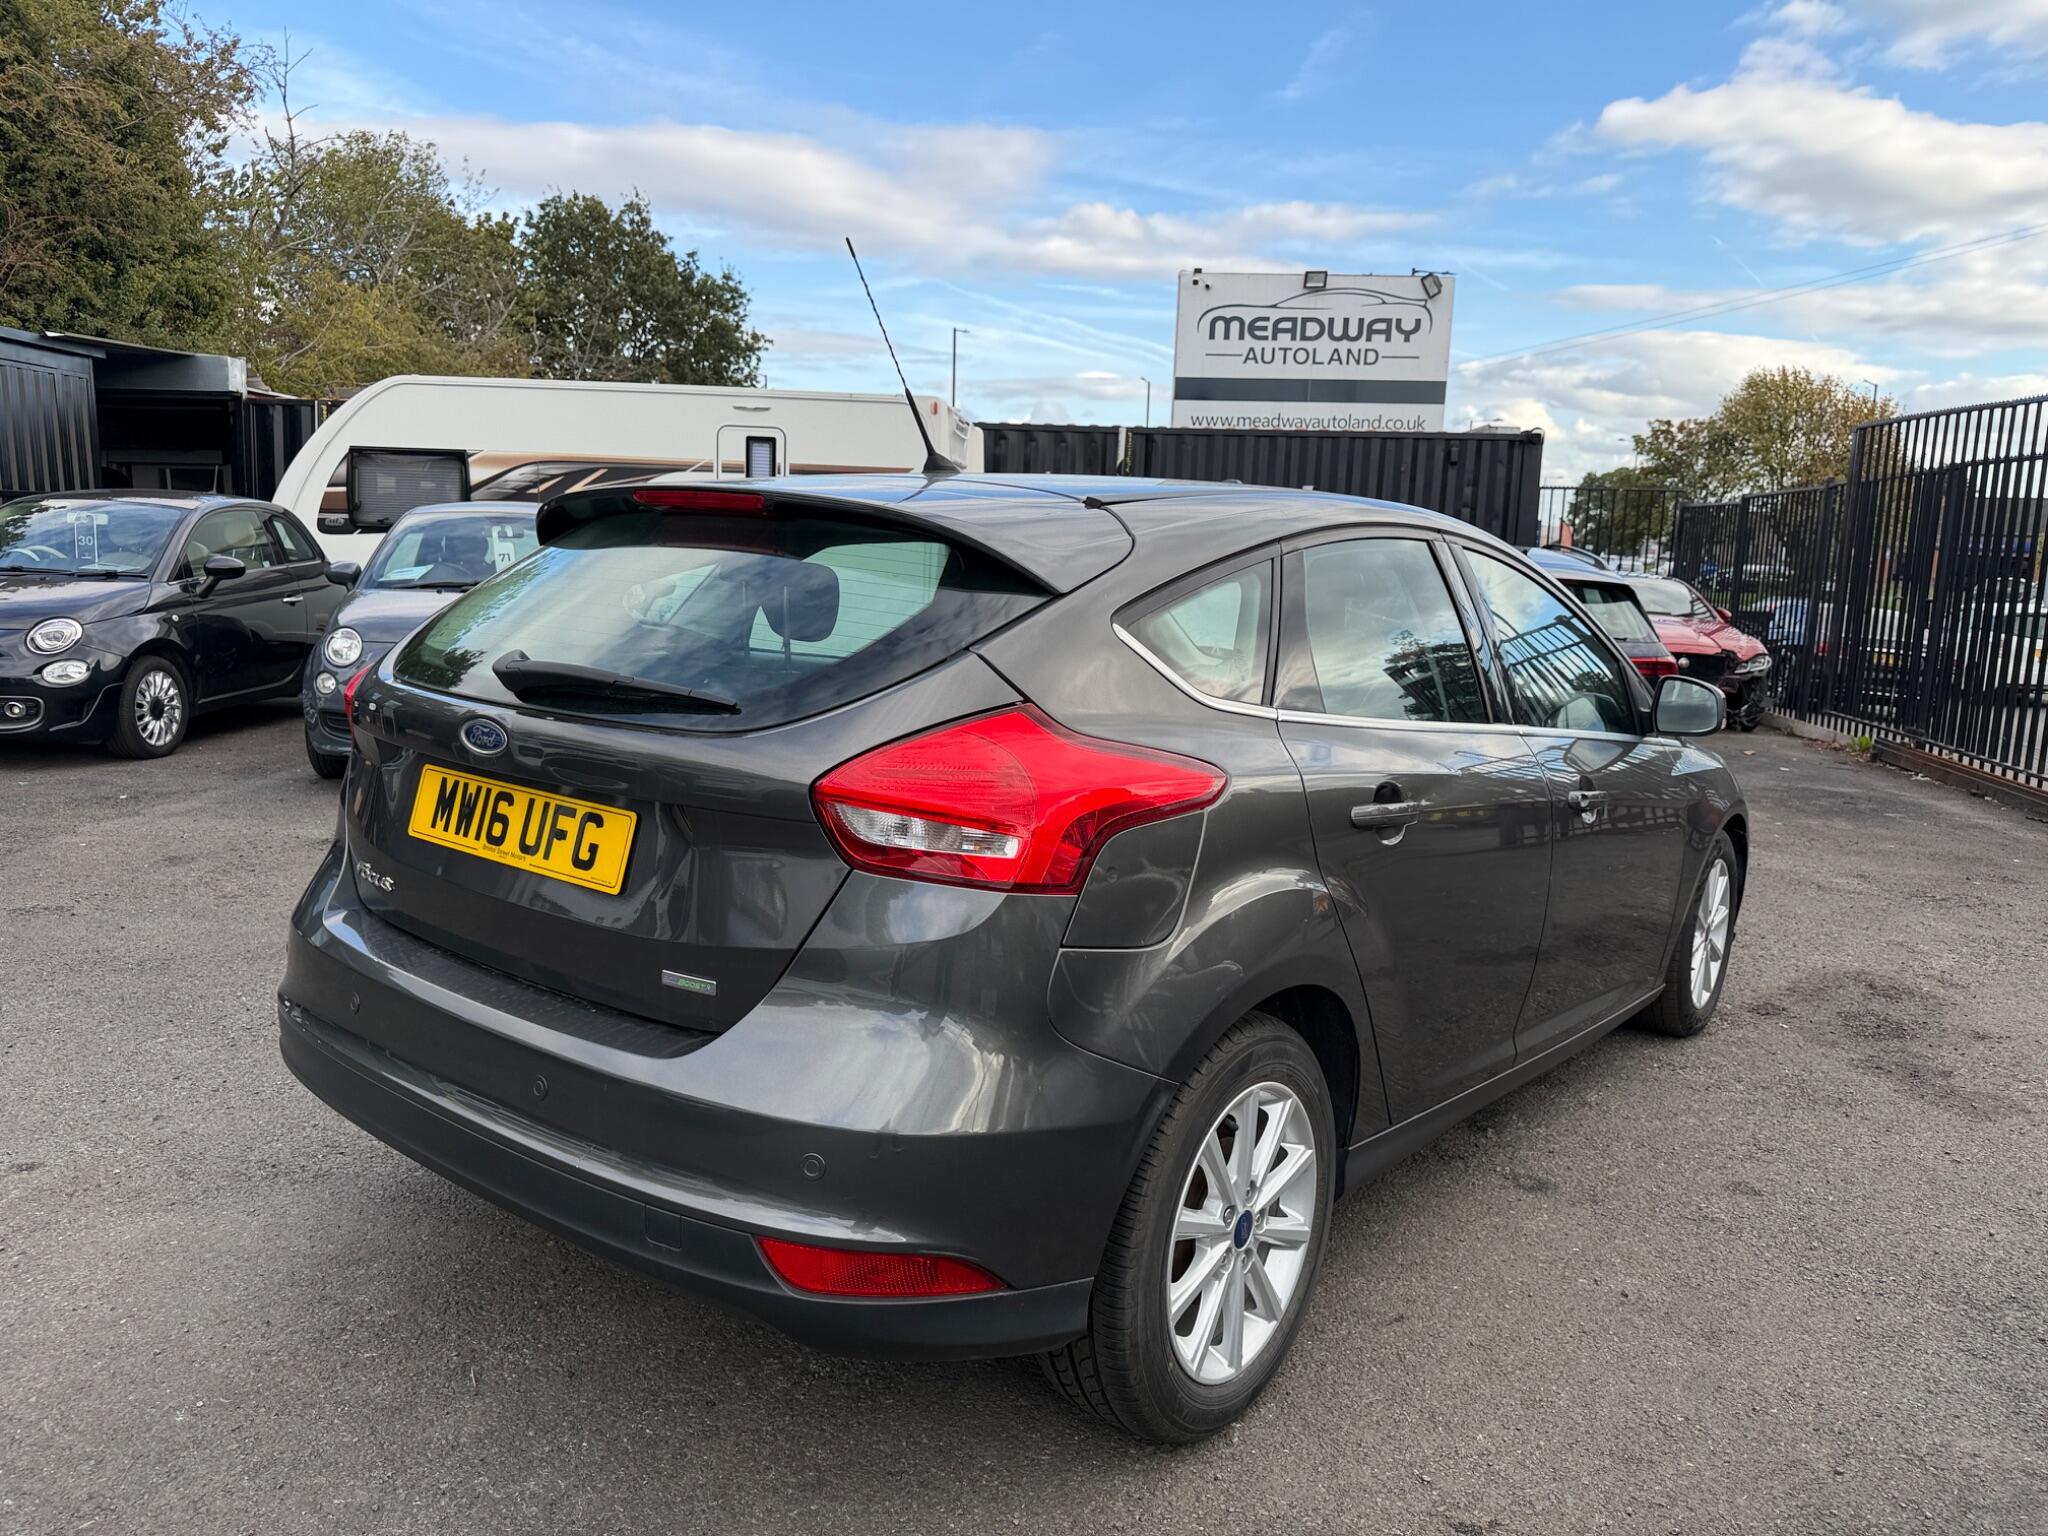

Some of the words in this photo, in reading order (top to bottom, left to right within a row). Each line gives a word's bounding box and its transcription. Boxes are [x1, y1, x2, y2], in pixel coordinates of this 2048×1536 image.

[1208, 316, 1422, 343] MEADWAY
[1243, 347, 1379, 366] AUTOLAND
[1191, 413, 1426, 431] www.meadwayautoland.co.uk
[78, 535, 94, 546] 30
[499, 553, 511, 562] 71
[470, 725, 498, 747] Ford
[431, 776, 515, 846] MW16
[518, 797, 605, 871] UFG
